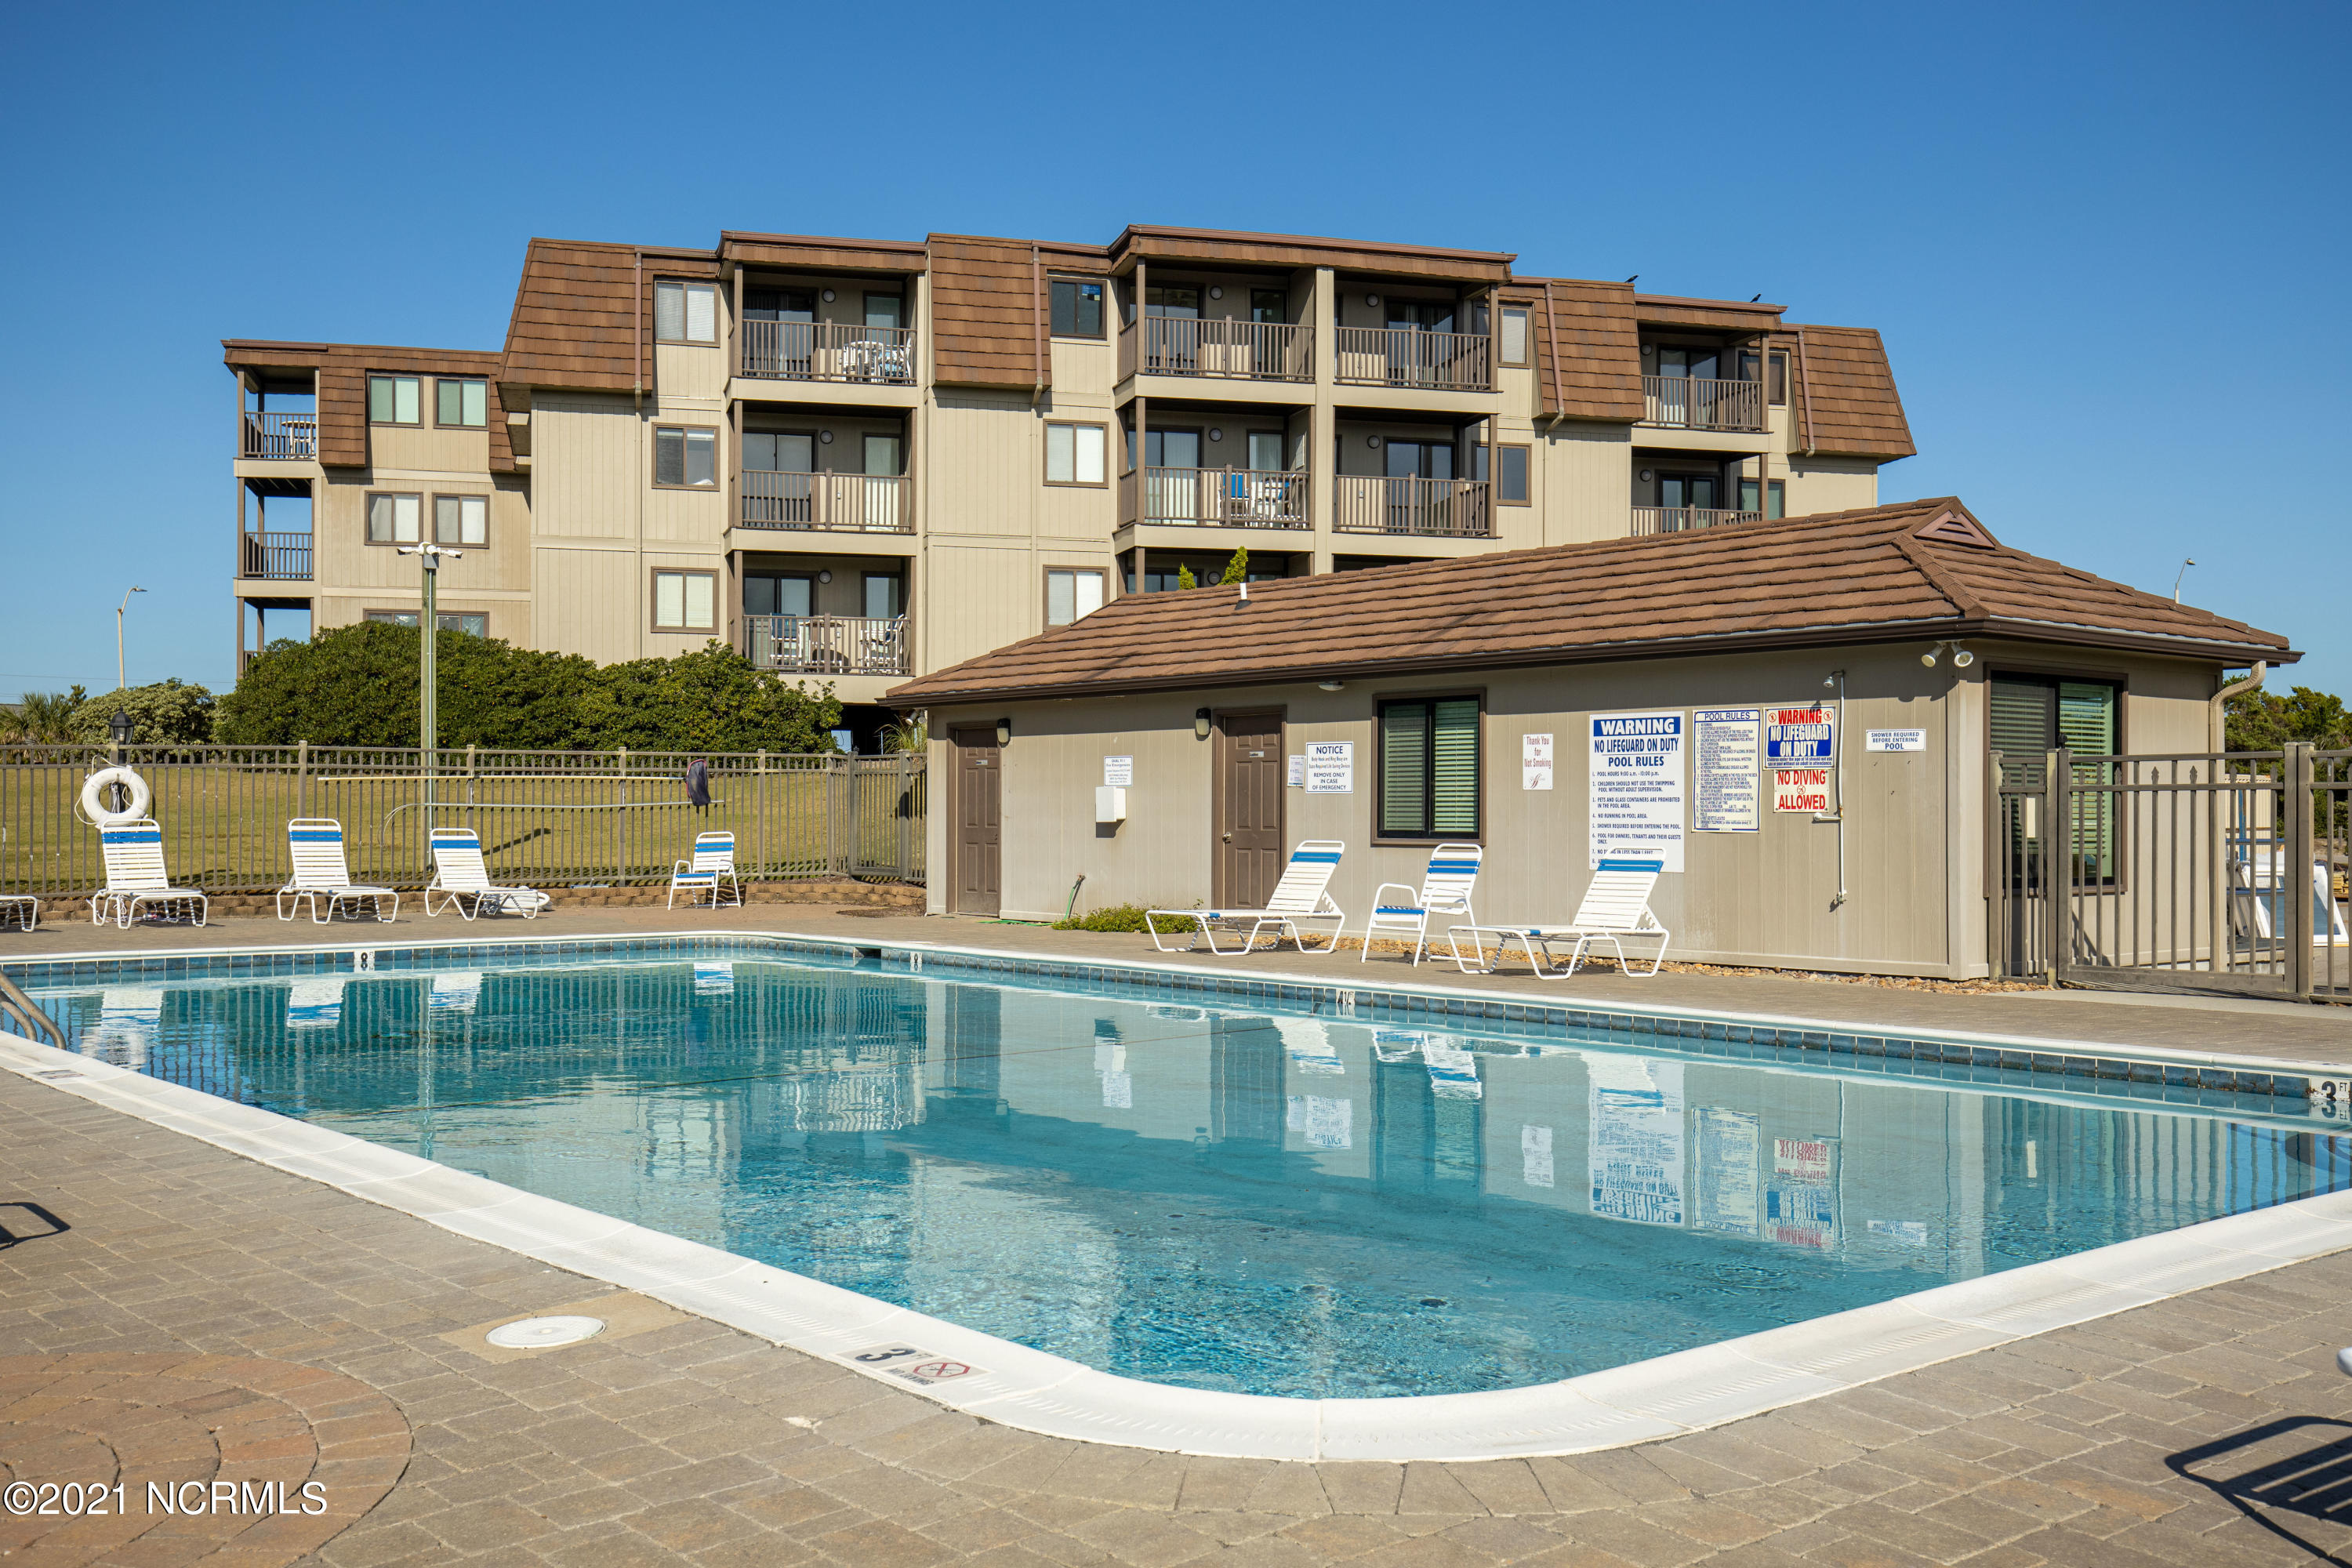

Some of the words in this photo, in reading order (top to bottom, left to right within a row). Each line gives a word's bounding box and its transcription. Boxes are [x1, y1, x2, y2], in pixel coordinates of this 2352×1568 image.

[1778, 709, 1821, 724] WARNING
[1600, 718, 1675, 735] WARNING
[1770, 726, 1781, 741] NO
[1783, 724, 1828, 741] LIFEGUARD
[1526, 736, 1540, 745] Thank
[1595, 740, 1604, 753] NO
[1607, 739, 1644, 753] LIFEGUARD
[1647, 739, 1657, 751] ON
[1661, 738, 1679, 751] DUTY
[1780, 742, 1791, 757] ON
[1794, 741, 1818, 757] DUTY
[1534, 758, 1552, 769] Smoking
[1608, 757, 1632, 767] POOL
[1635, 756, 1664, 767] RULES
[1778, 770, 1790, 785] NO
[1794, 769, 1825, 785] DIVING
[1779, 795, 1825, 809] ALLOWED
[2321, 1081, 2336, 1101] 3
[2339, 1083, 2347, 1092] FT
[855, 1348, 916, 1362] 3
